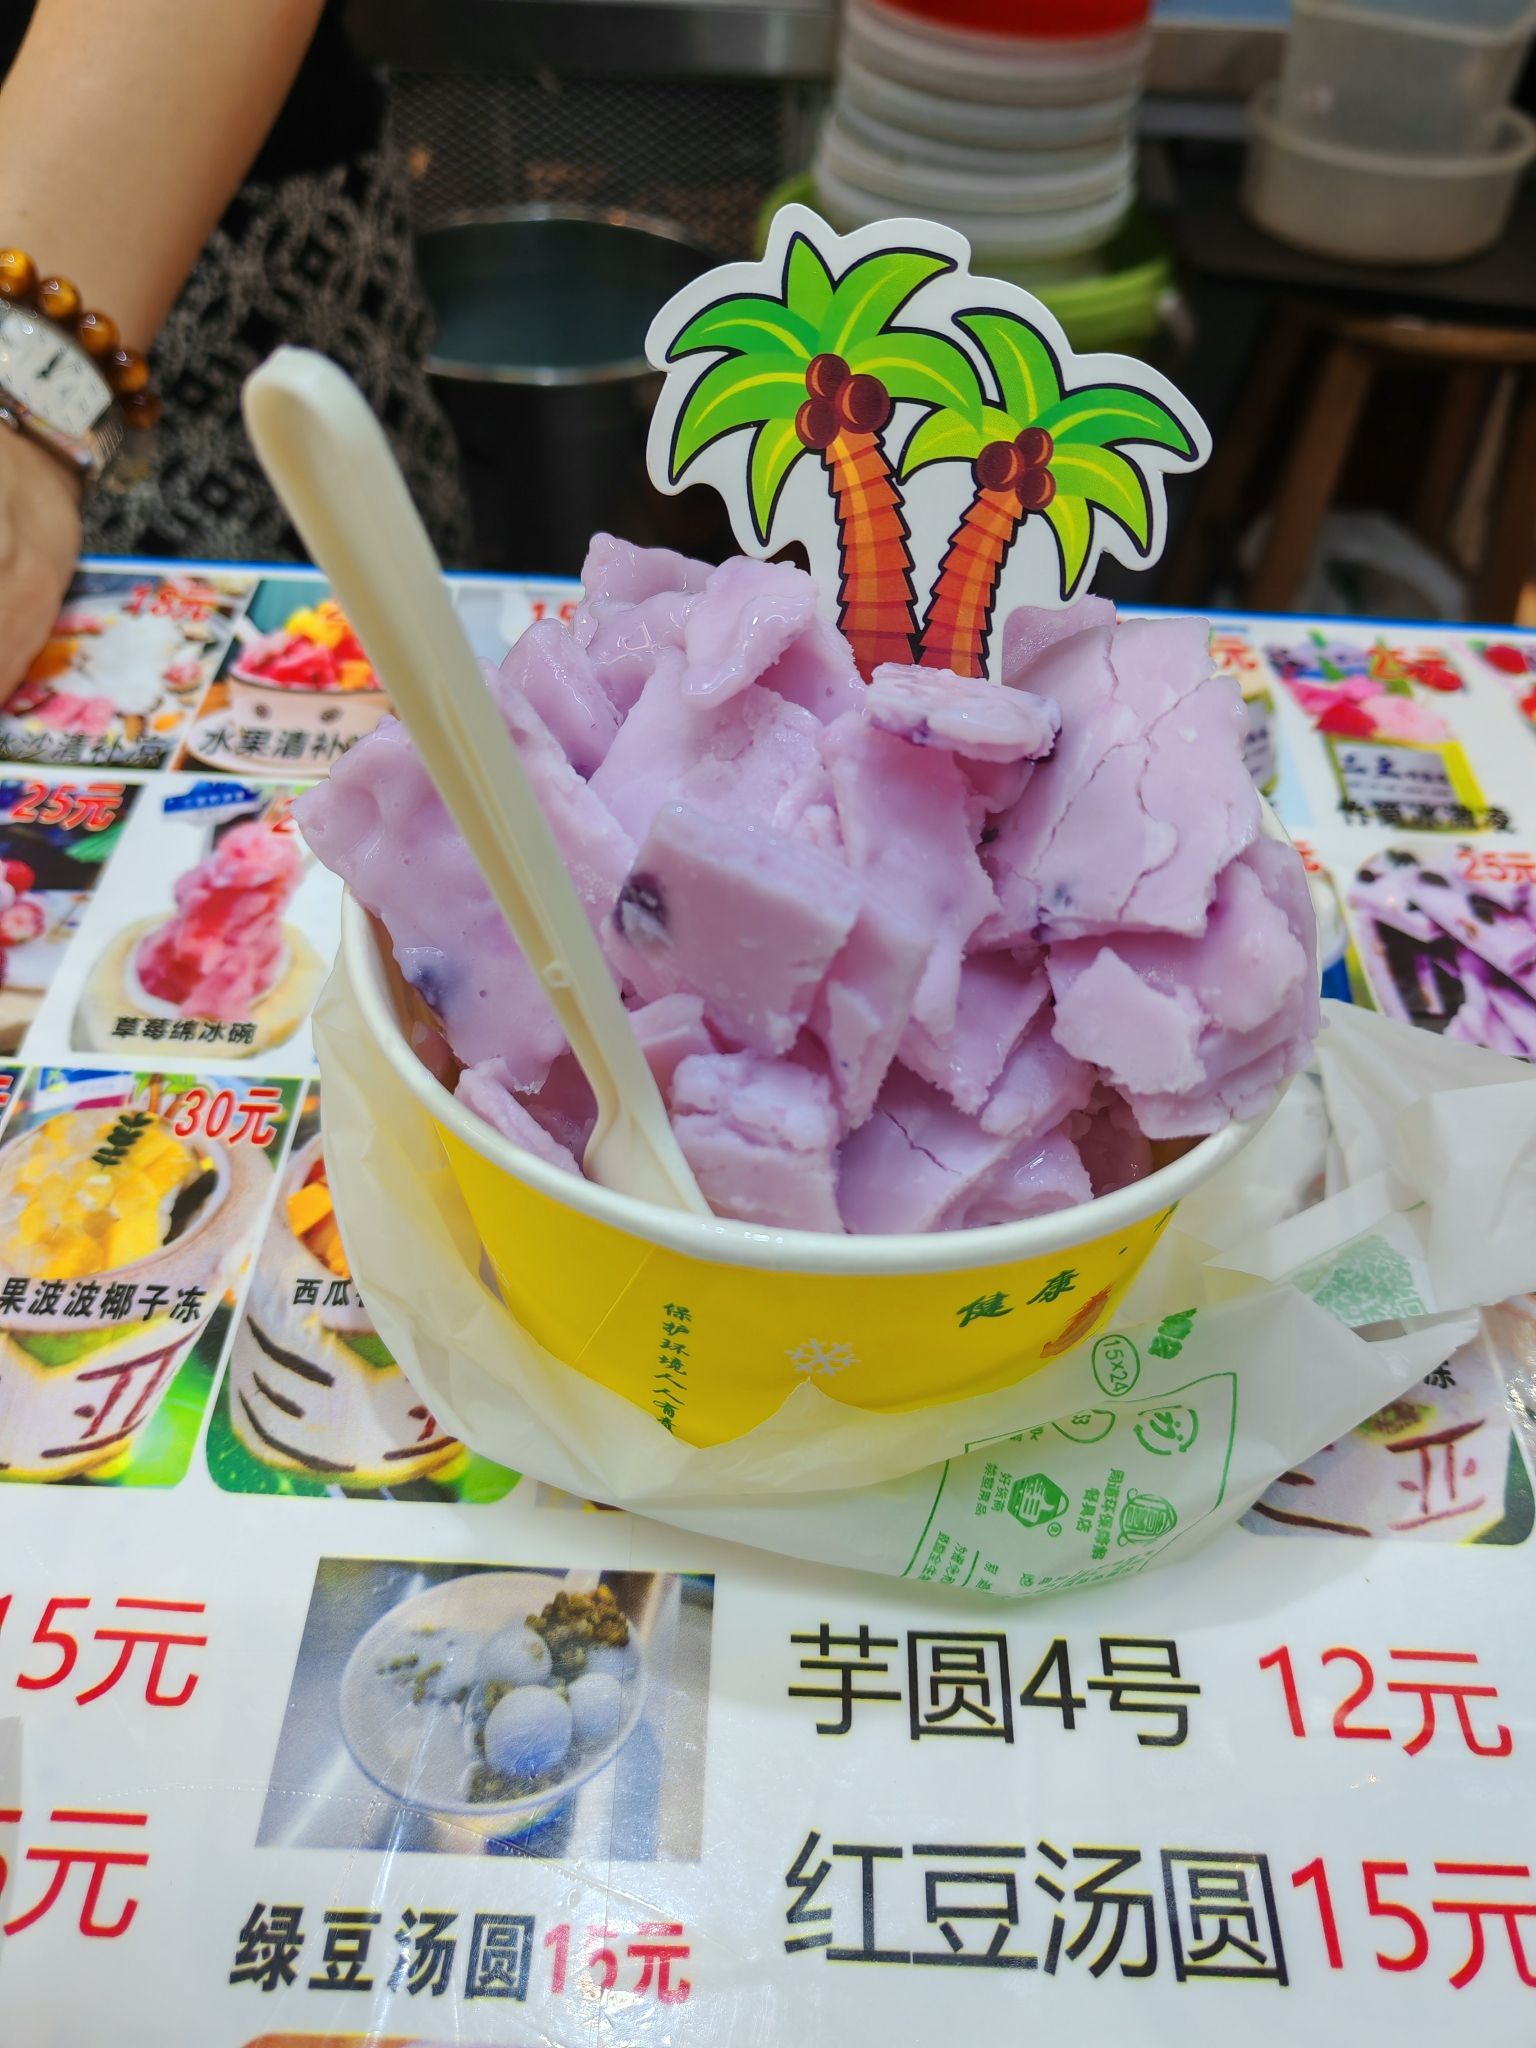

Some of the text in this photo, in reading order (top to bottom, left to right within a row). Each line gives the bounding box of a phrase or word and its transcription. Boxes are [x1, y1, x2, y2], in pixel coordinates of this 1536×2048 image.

[12, 780, 126, 831] 25元
[112, 1016, 257, 1046] 草莓绵冰碗
[174, 1087, 282, 1146] 30元
[0, 1277, 207, 1324] 果波波椰子冻
[957, 1268, 1080, 1328] 健康
[788, 1622, 1513, 1759] 芋圆4号 12元
[785, 1832, 1536, 1990] 红豆汤圆 15元
[229, 1903, 693, 2006] 绿豆汤圆 15元
